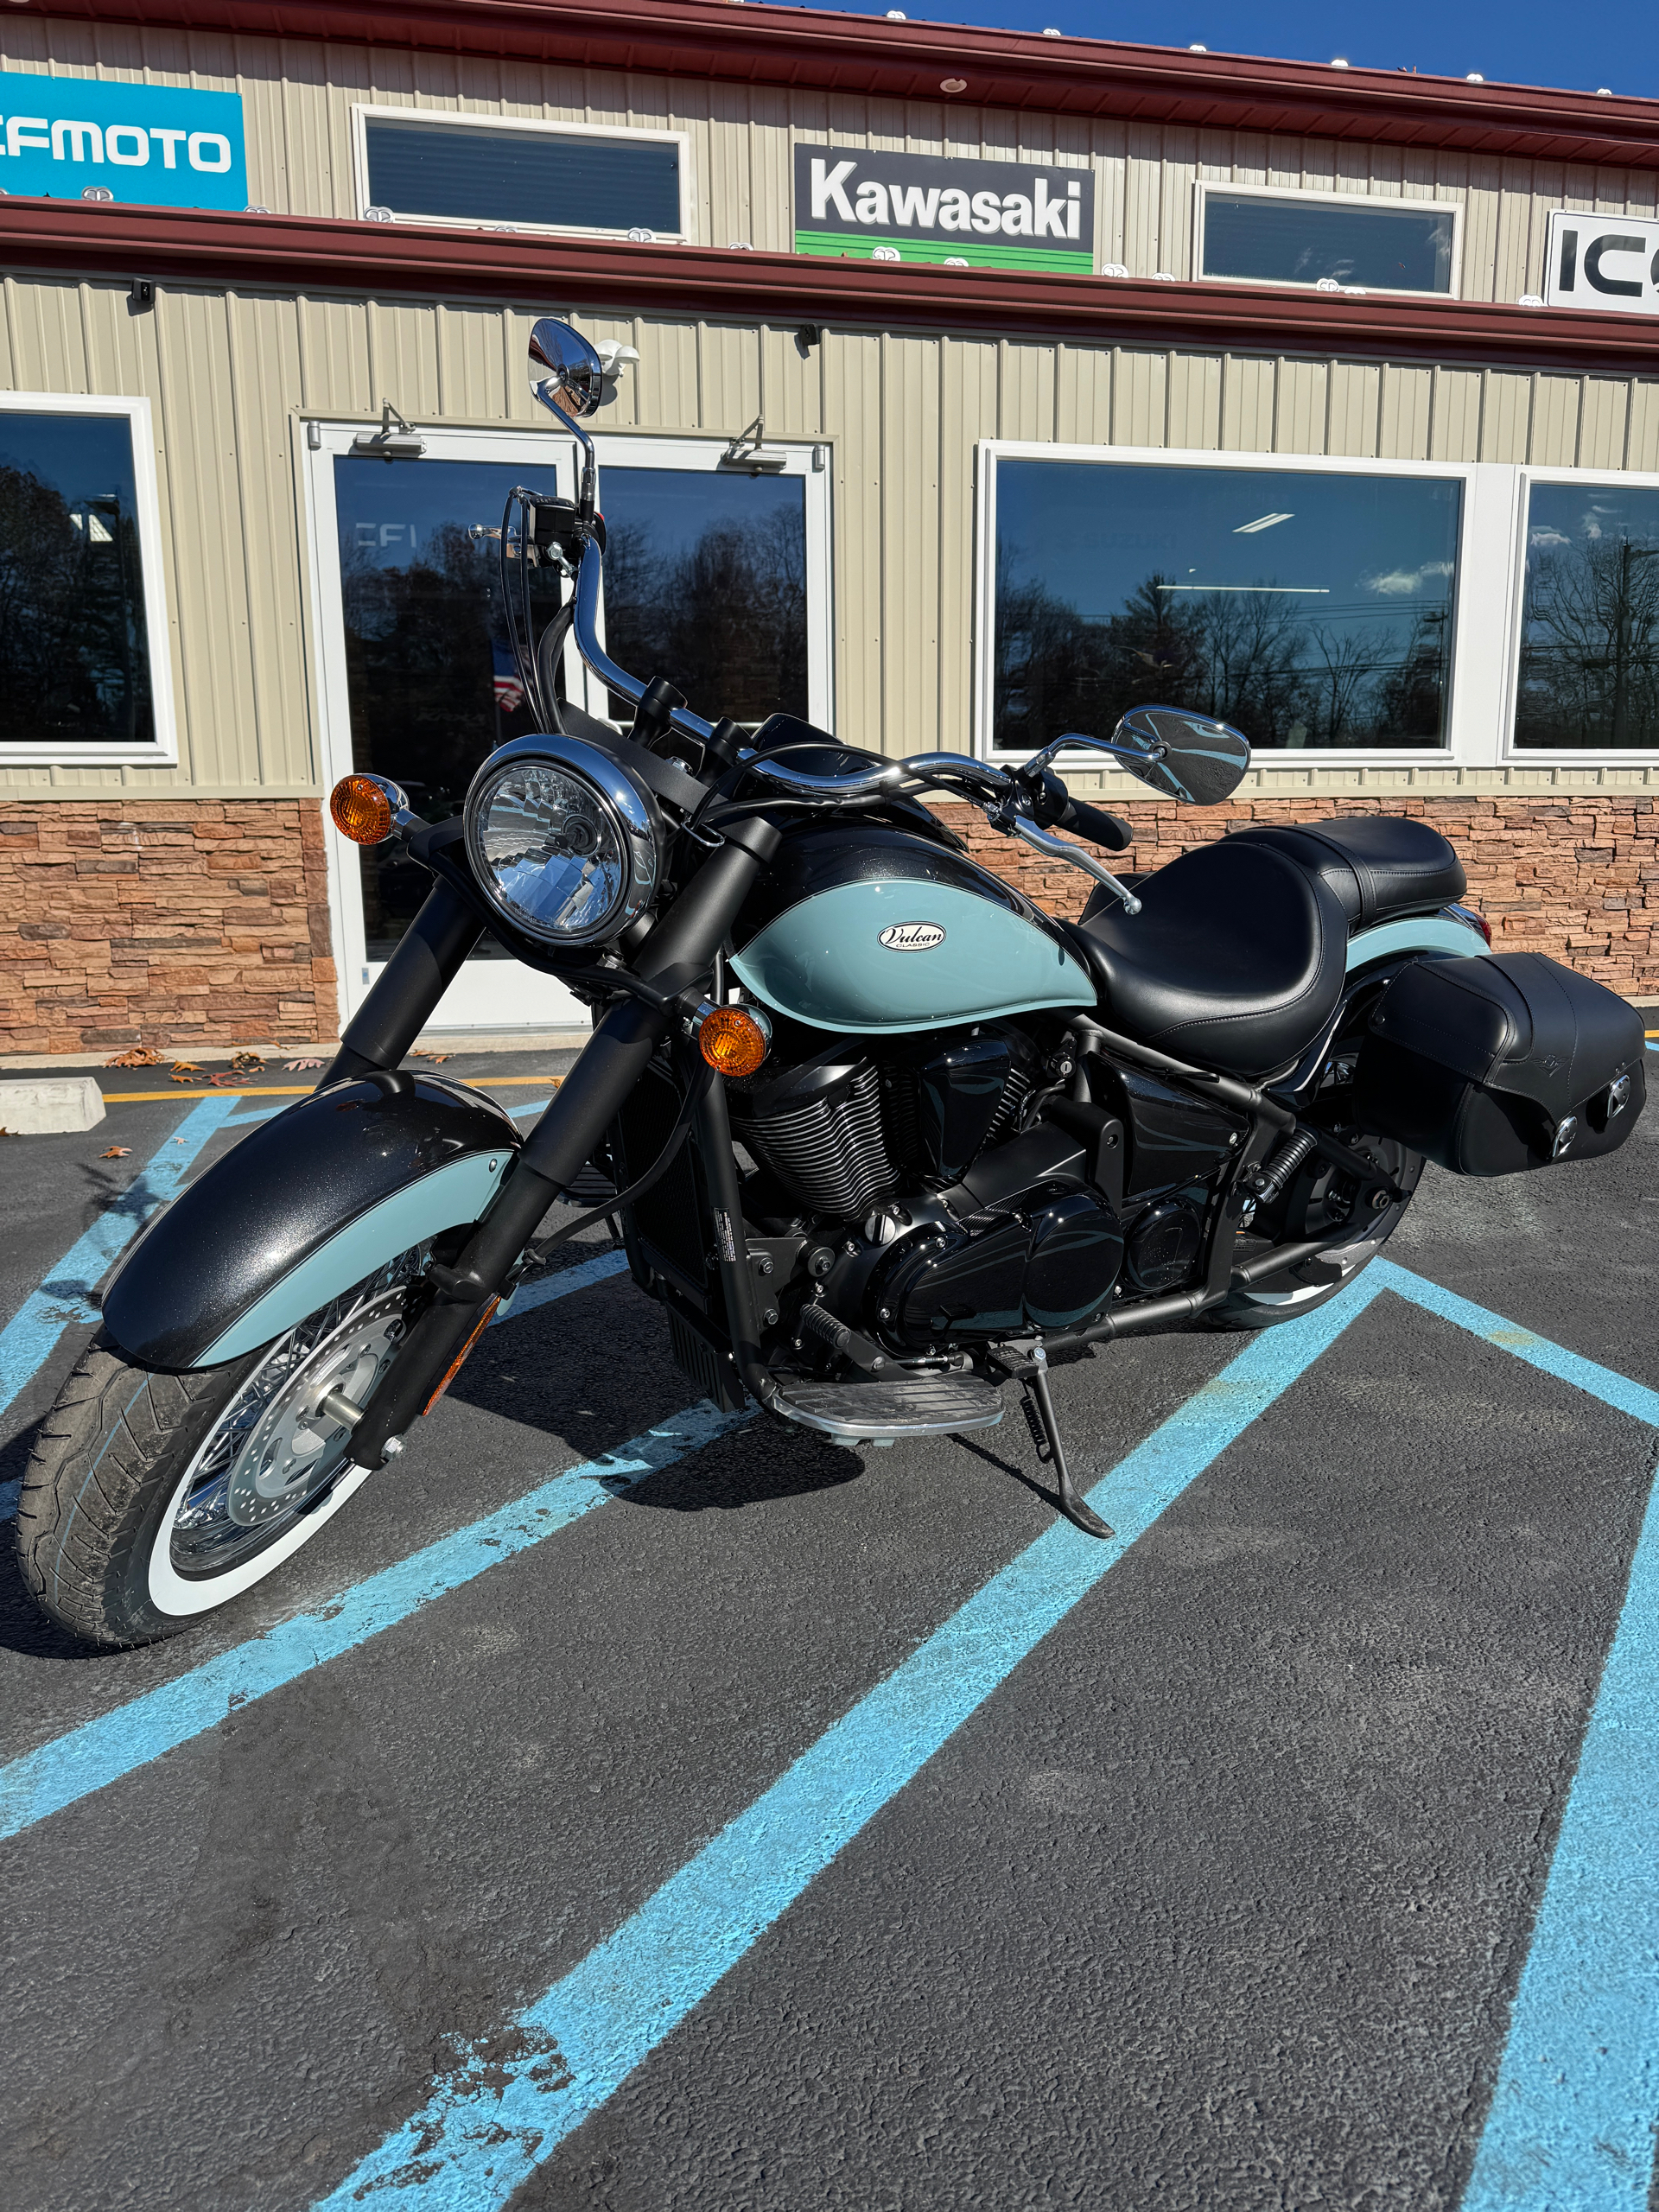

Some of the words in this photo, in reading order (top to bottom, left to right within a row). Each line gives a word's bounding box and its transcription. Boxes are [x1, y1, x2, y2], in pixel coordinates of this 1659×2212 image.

[0, 114, 232, 174] FMOTO
[810, 158, 1081, 239] Kawasaki
[1559, 229, 1659, 298] IC
[885, 926, 942, 944] Vulcan
